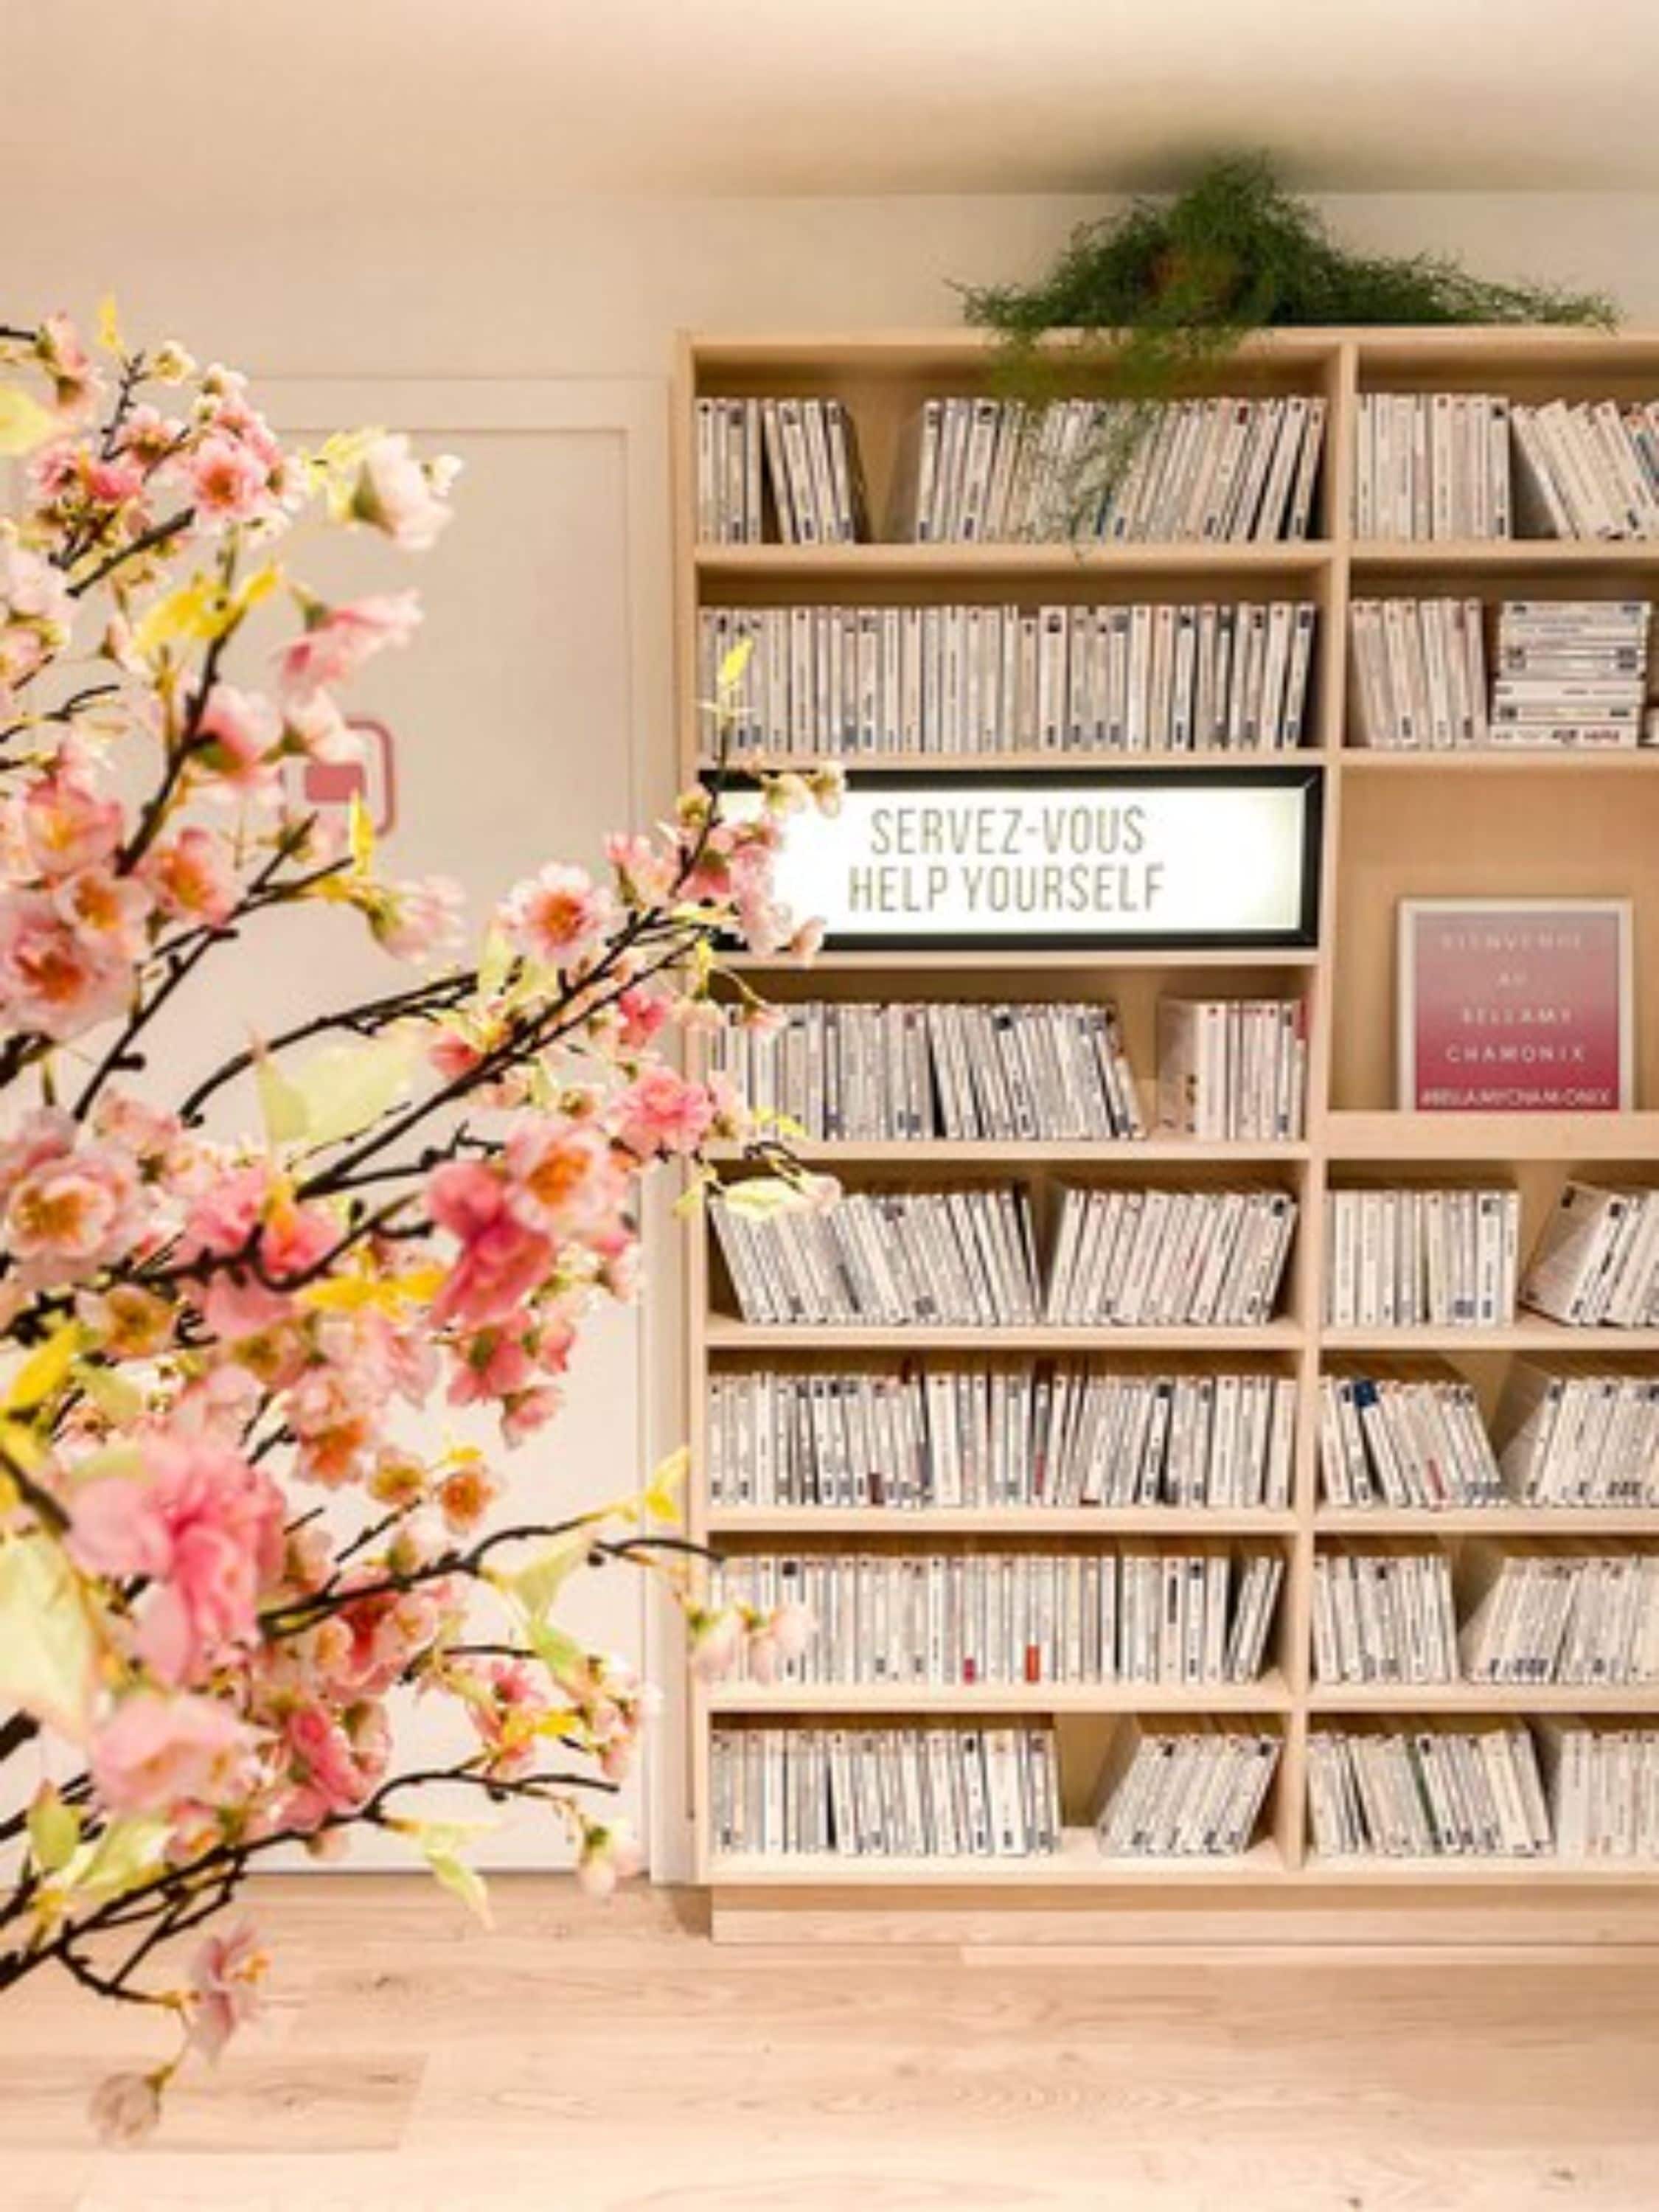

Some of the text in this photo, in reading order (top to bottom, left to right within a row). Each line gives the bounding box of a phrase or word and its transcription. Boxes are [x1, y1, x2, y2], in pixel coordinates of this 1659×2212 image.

[870, 804, 1145, 855] SERVEZ-VOUS
[848, 863, 1163, 913] HELP YOURSELF
[1445, 1045, 1585, 1063] CHAMONIX
